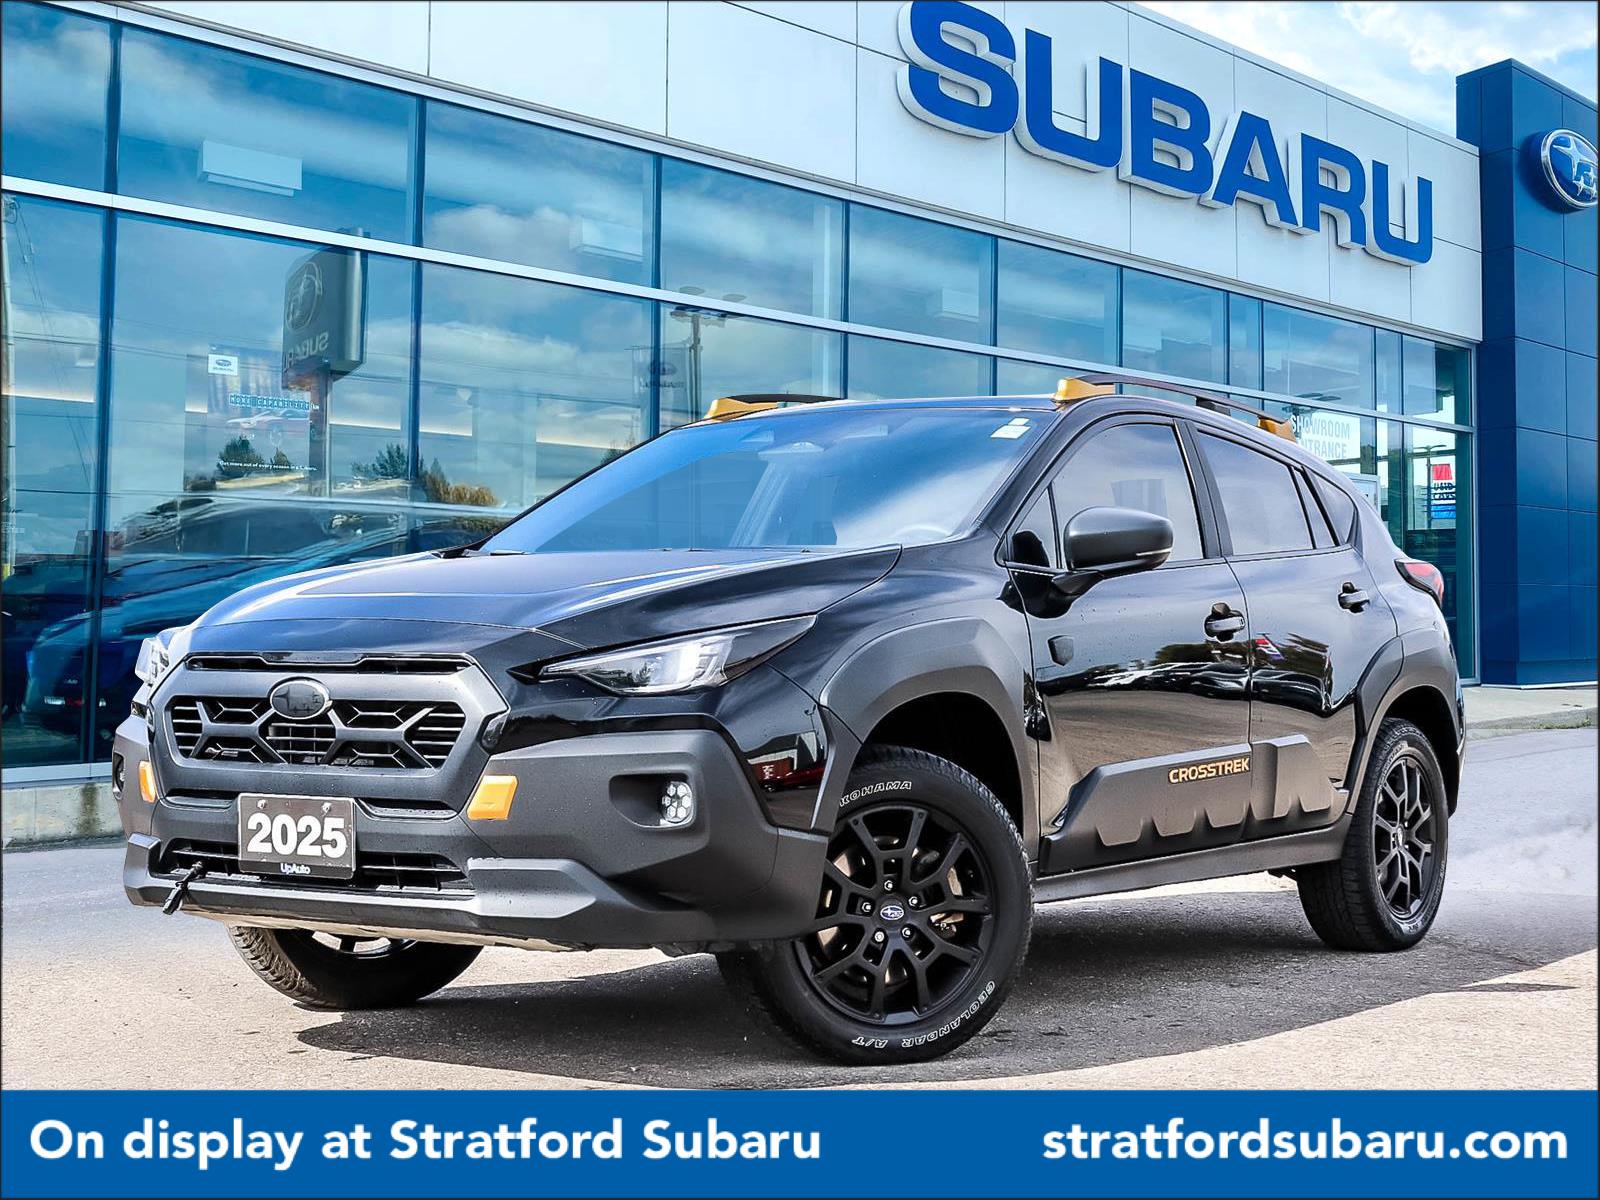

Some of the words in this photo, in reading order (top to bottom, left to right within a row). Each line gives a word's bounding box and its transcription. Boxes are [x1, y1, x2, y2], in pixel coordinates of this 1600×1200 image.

[898, 0, 1434, 266] SUBARU
[1291, 415, 1350, 439] SHOWROOM
[1297, 438, 1347, 458] NTRANCE
[1168, 757, 1250, 784] CROSSTREK
[840, 781, 912, 807] KOHAMA
[247, 813, 347, 858] 2025
[280, 862, 311, 875] UpAuto
[901, 981, 996, 1047] GEOLANDAR
[851, 1036, 888, 1049] A/T
